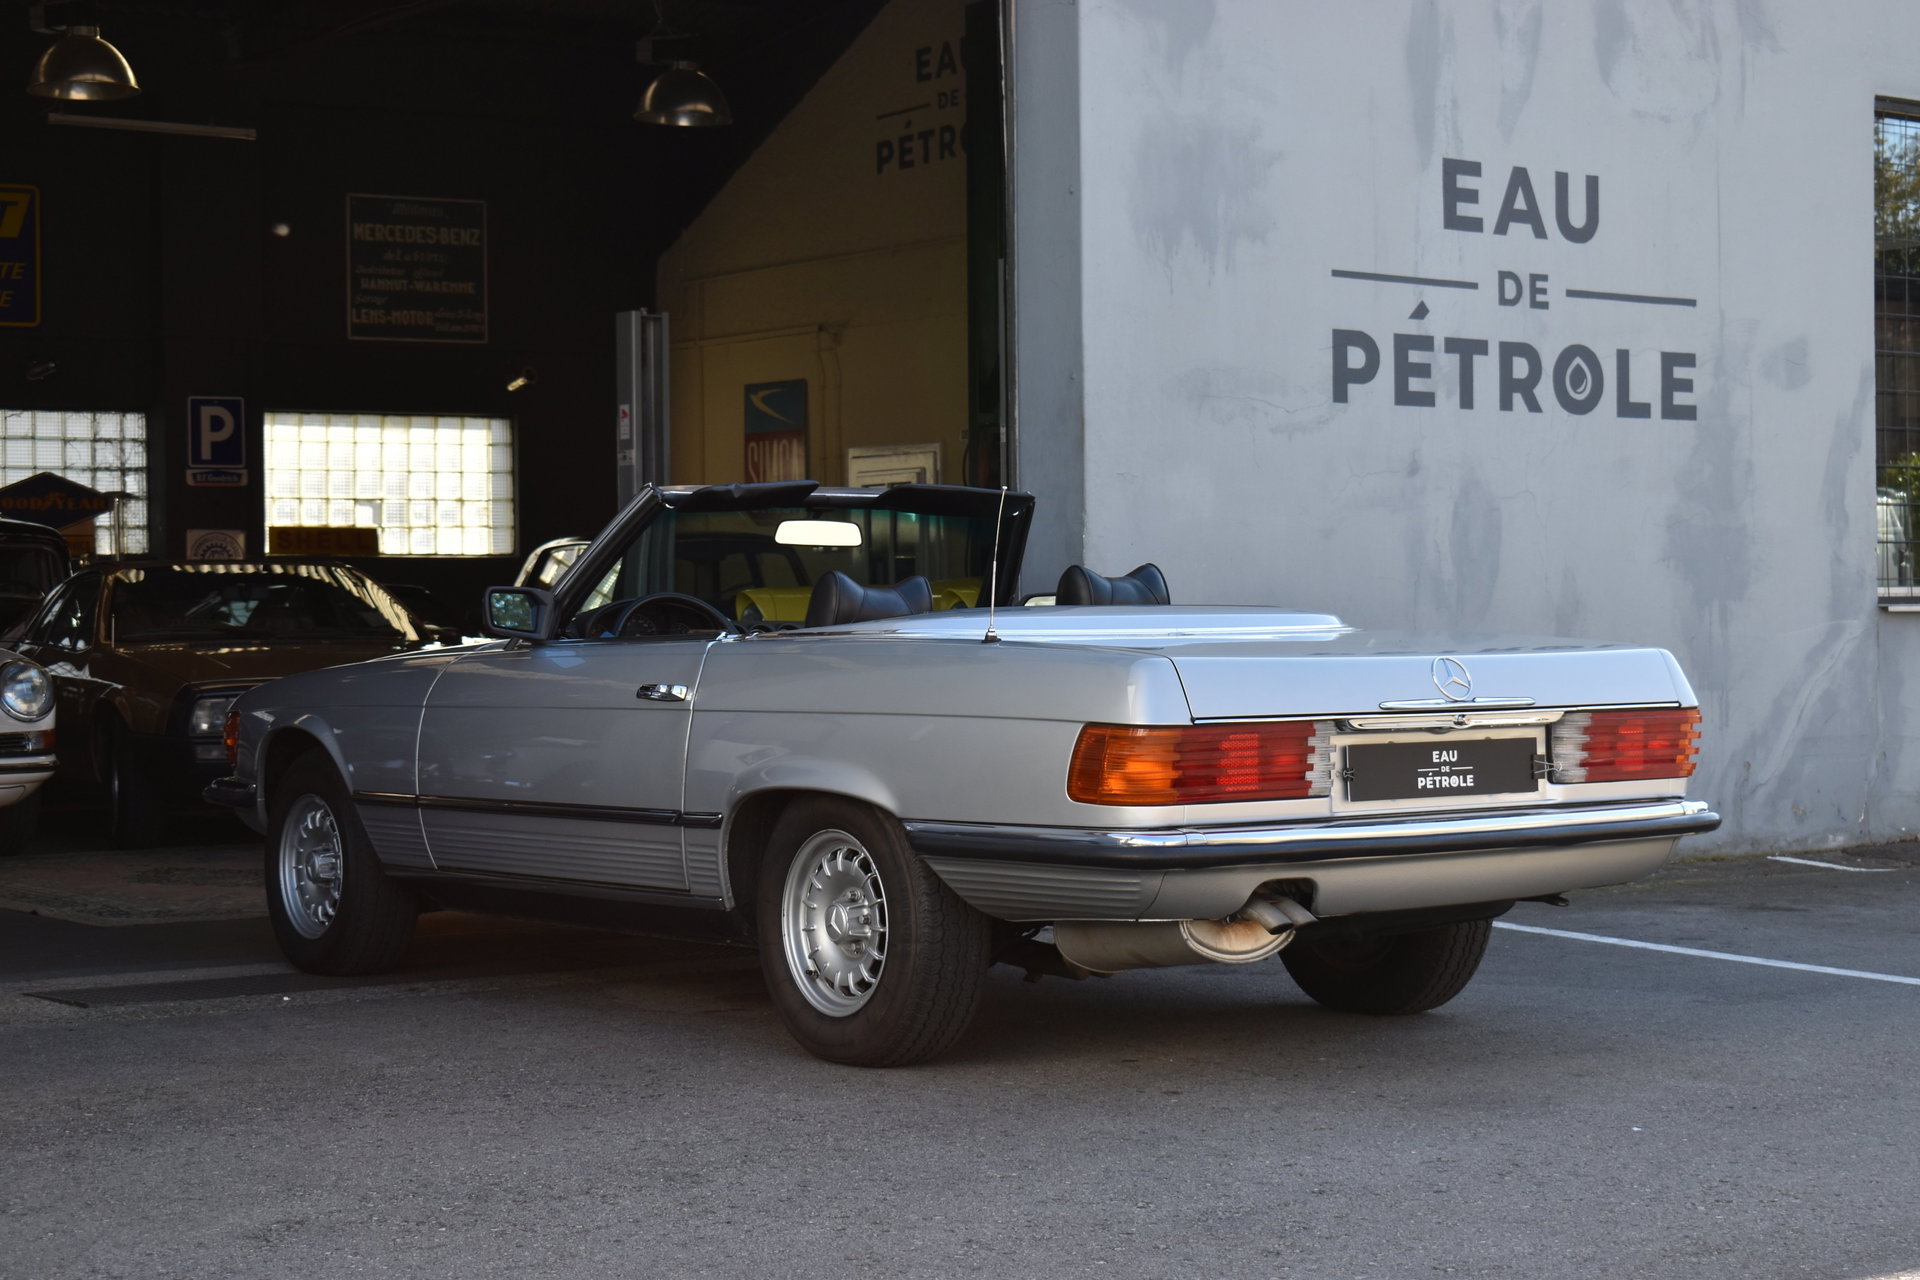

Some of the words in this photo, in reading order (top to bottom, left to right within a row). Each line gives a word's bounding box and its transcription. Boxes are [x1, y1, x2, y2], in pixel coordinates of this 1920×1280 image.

[937, 89, 960, 109] DE
[1442, 157, 1599, 244] EAU
[1498, 270, 1549, 309] DE
[1332, 300, 1697, 421] PÉTROLE
[200, 406, 235, 460] P
[277, 530, 369, 550] SHELL
[1432, 750, 1458, 762] EAU
[1440, 765, 1450, 773] DE
[1417, 772, 1474, 789] PÉTROLE
